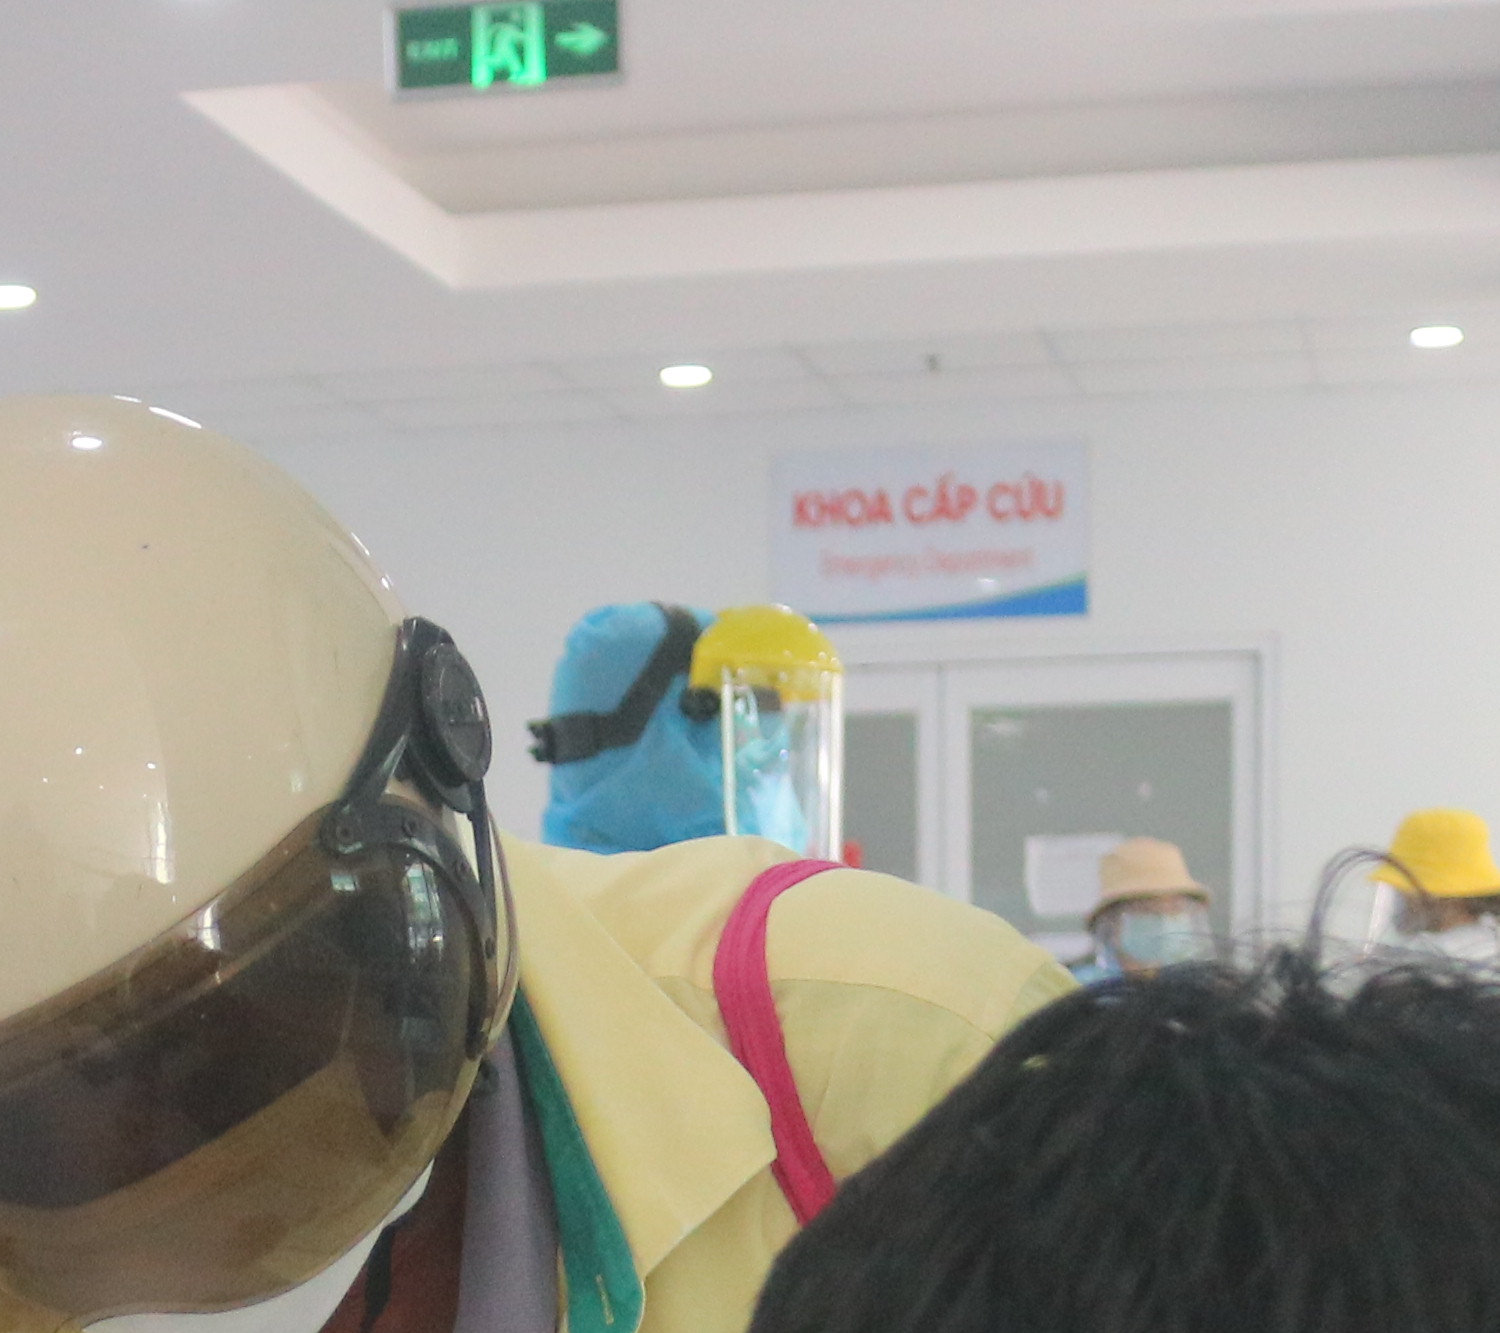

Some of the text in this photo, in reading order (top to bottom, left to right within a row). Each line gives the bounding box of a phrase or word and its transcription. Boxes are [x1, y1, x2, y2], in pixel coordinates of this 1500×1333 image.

[791, 468, 1066, 530] KHOA CẤP CỨU
